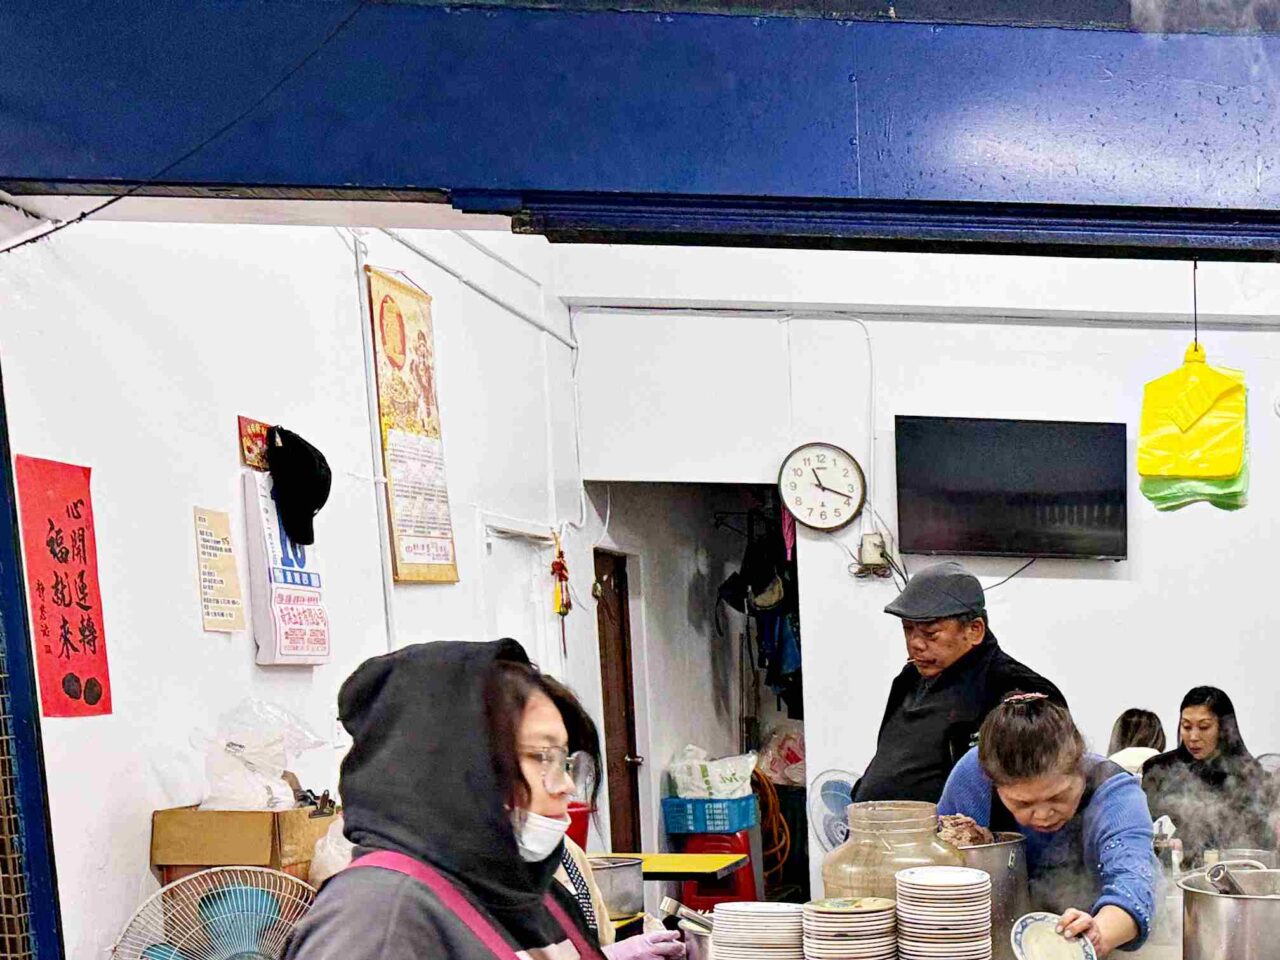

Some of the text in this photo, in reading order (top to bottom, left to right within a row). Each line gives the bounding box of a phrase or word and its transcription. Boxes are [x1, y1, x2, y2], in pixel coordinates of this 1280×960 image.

[803, 457, 810, 466] 11
[816, 454, 826, 463] 12
[793, 468, 803, 477] 10
[843, 468, 849, 478] 2
[790, 481, 797, 491] 9
[848, 484, 855, 493] 3
[795, 497, 802, 506] 8
[808, 508, 814, 517] 7
[820, 511, 827, 520] 6
[834, 508, 841, 517] 5
[66, 499, 97, 655] 心開運轉
[47, 518, 80, 660] 福就來
